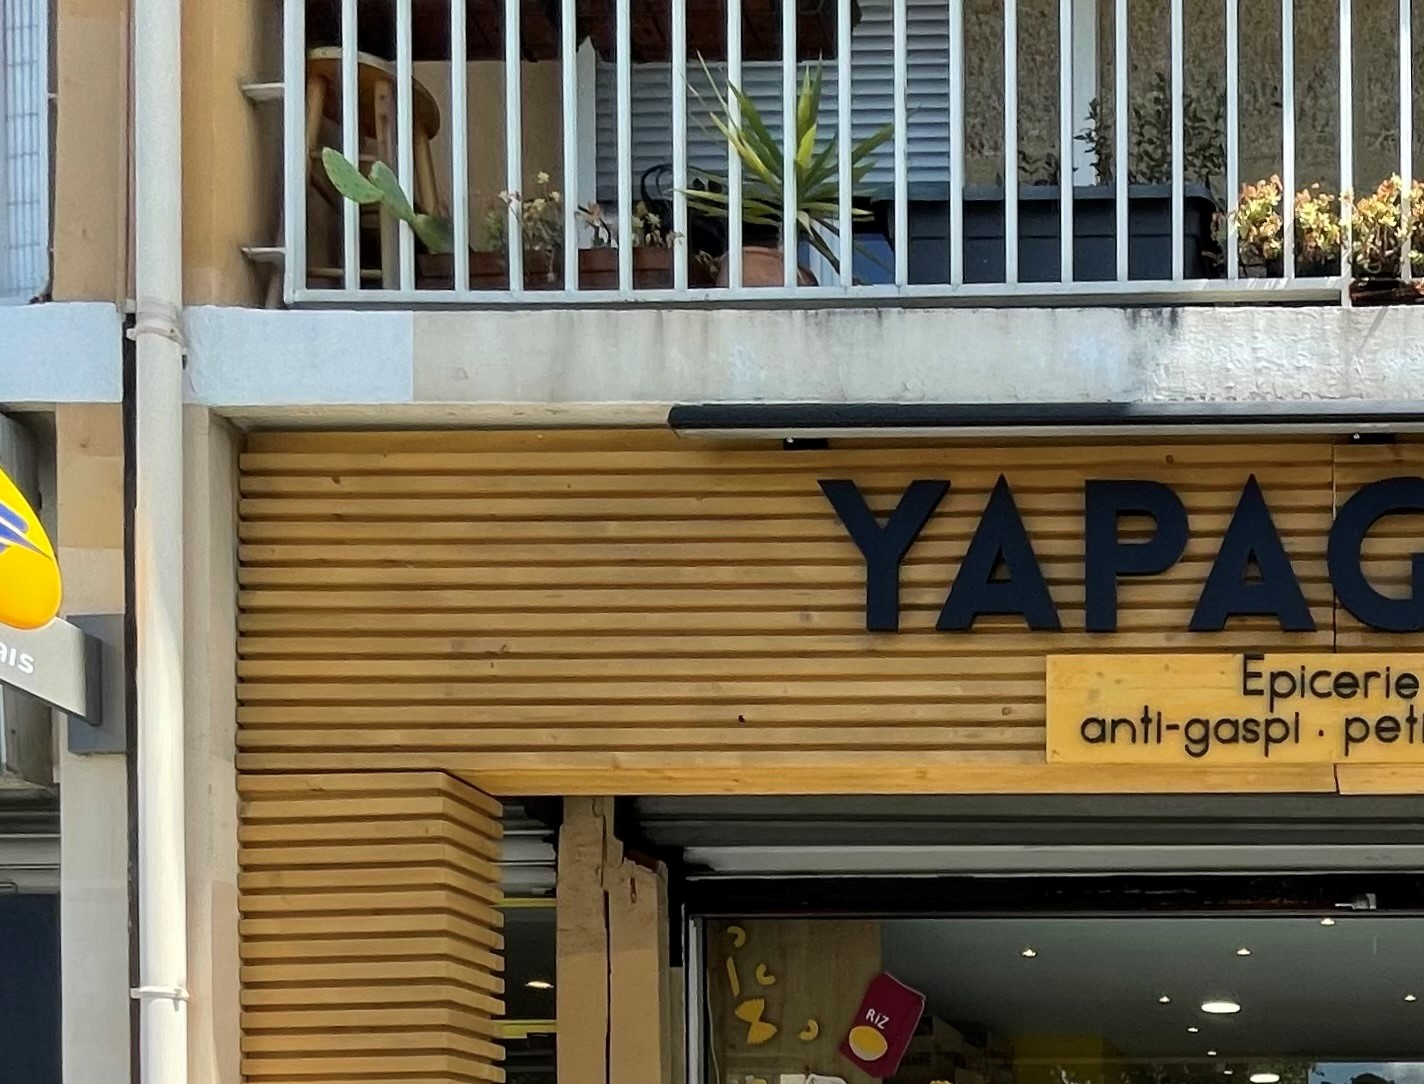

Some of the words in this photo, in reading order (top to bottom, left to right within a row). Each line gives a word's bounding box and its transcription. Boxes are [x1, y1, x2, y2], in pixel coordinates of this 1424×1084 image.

[1241, 653, 1421, 712] Epicerie
[1080, 705, 1301, 758] anti-gaspi
[865, 1008, 890, 1030] RIZ
